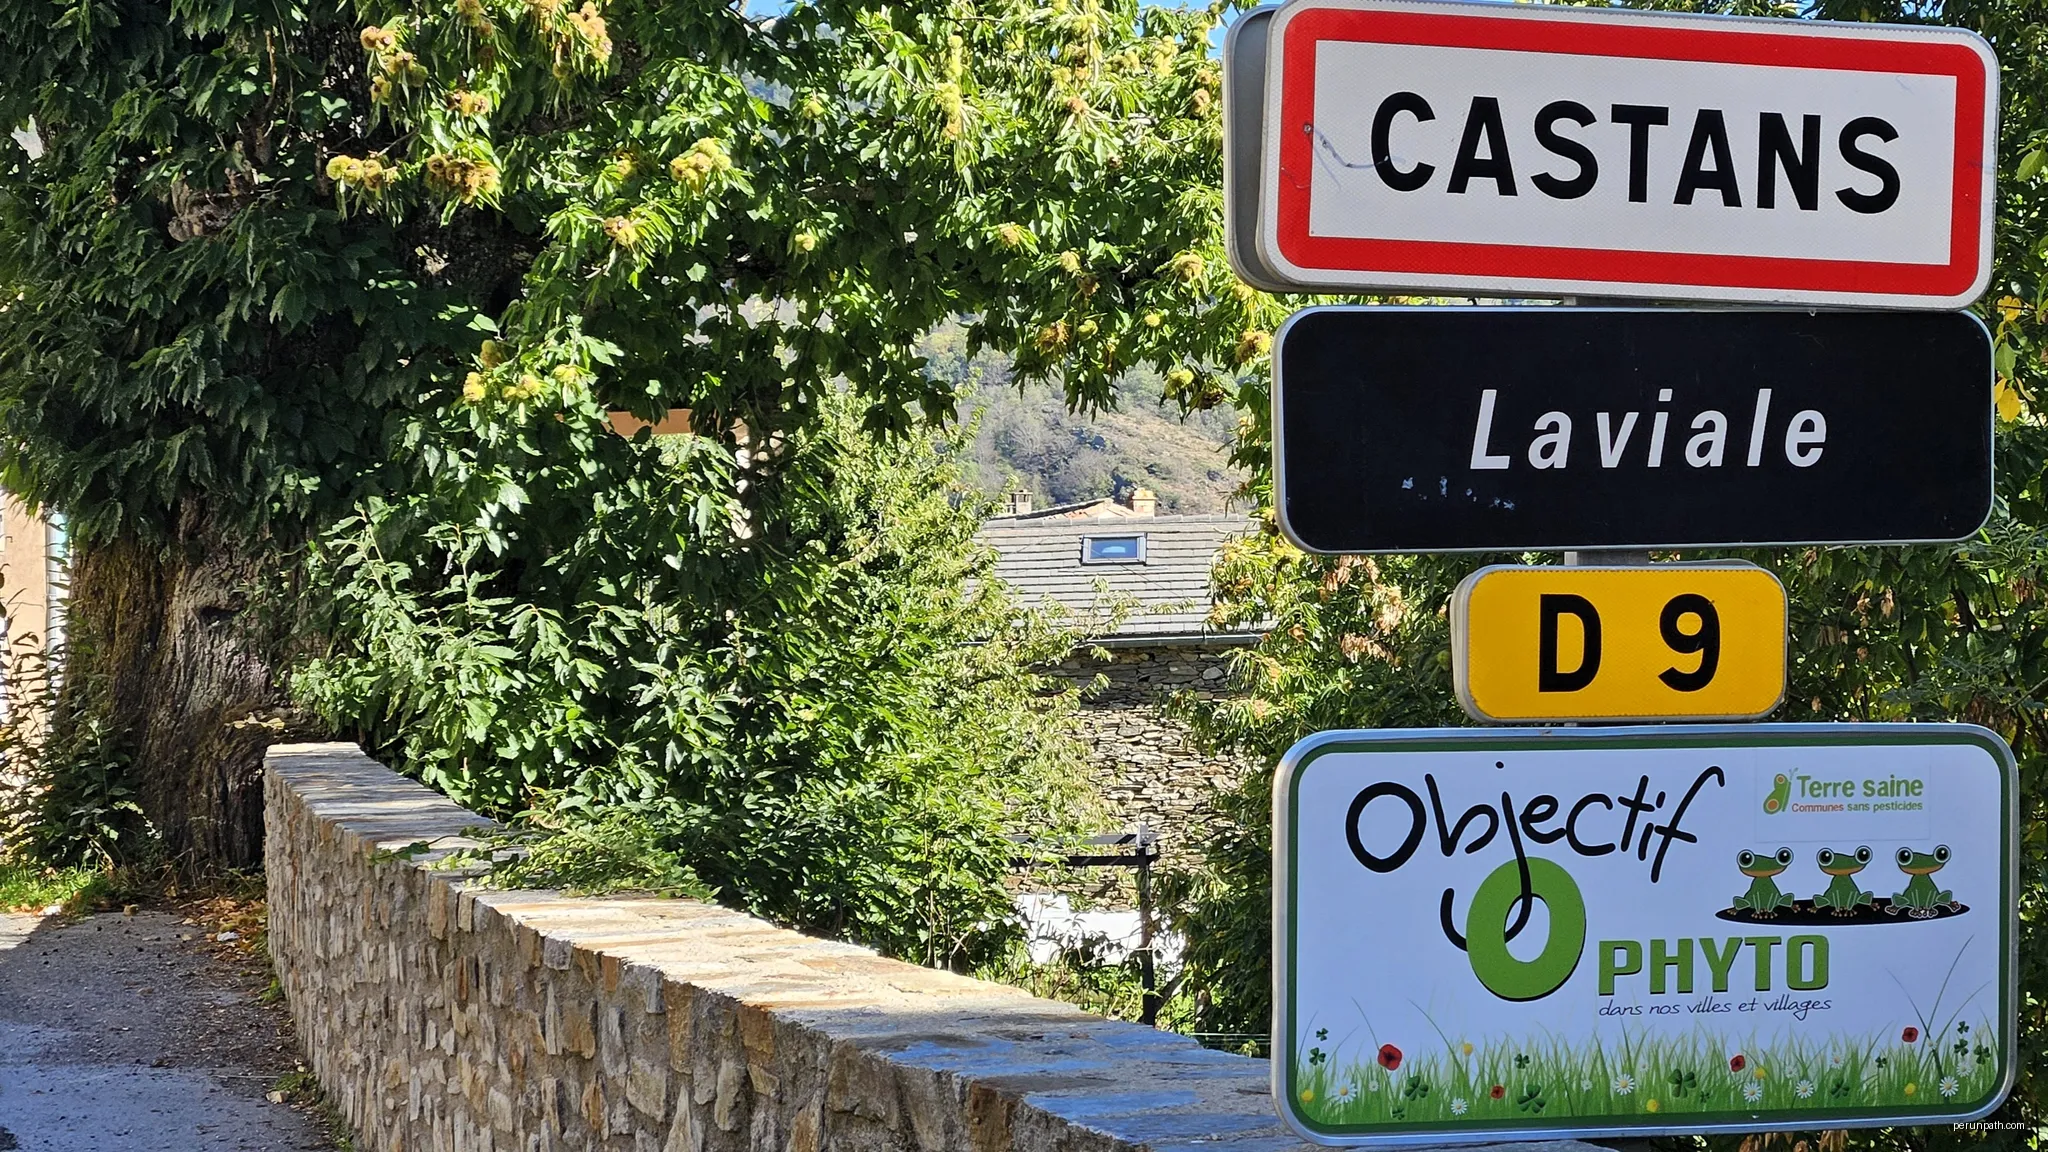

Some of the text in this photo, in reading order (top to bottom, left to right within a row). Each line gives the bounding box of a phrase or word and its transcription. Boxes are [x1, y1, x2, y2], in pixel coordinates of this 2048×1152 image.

[1370, 91, 1901, 215] CASTANS
[1469, 387, 1828, 471] Laviale
[1538, 592, 1721, 693] D 9
[1791, 800, 1924, 814] Communes sans pesticides
[1796, 773, 1924, 798] Terre saine
[1345, 761, 1726, 953] Objectif
[1598, 934, 1830, 997] PHYTO
[1598, 993, 1833, 1022] dans nos villes et villages
